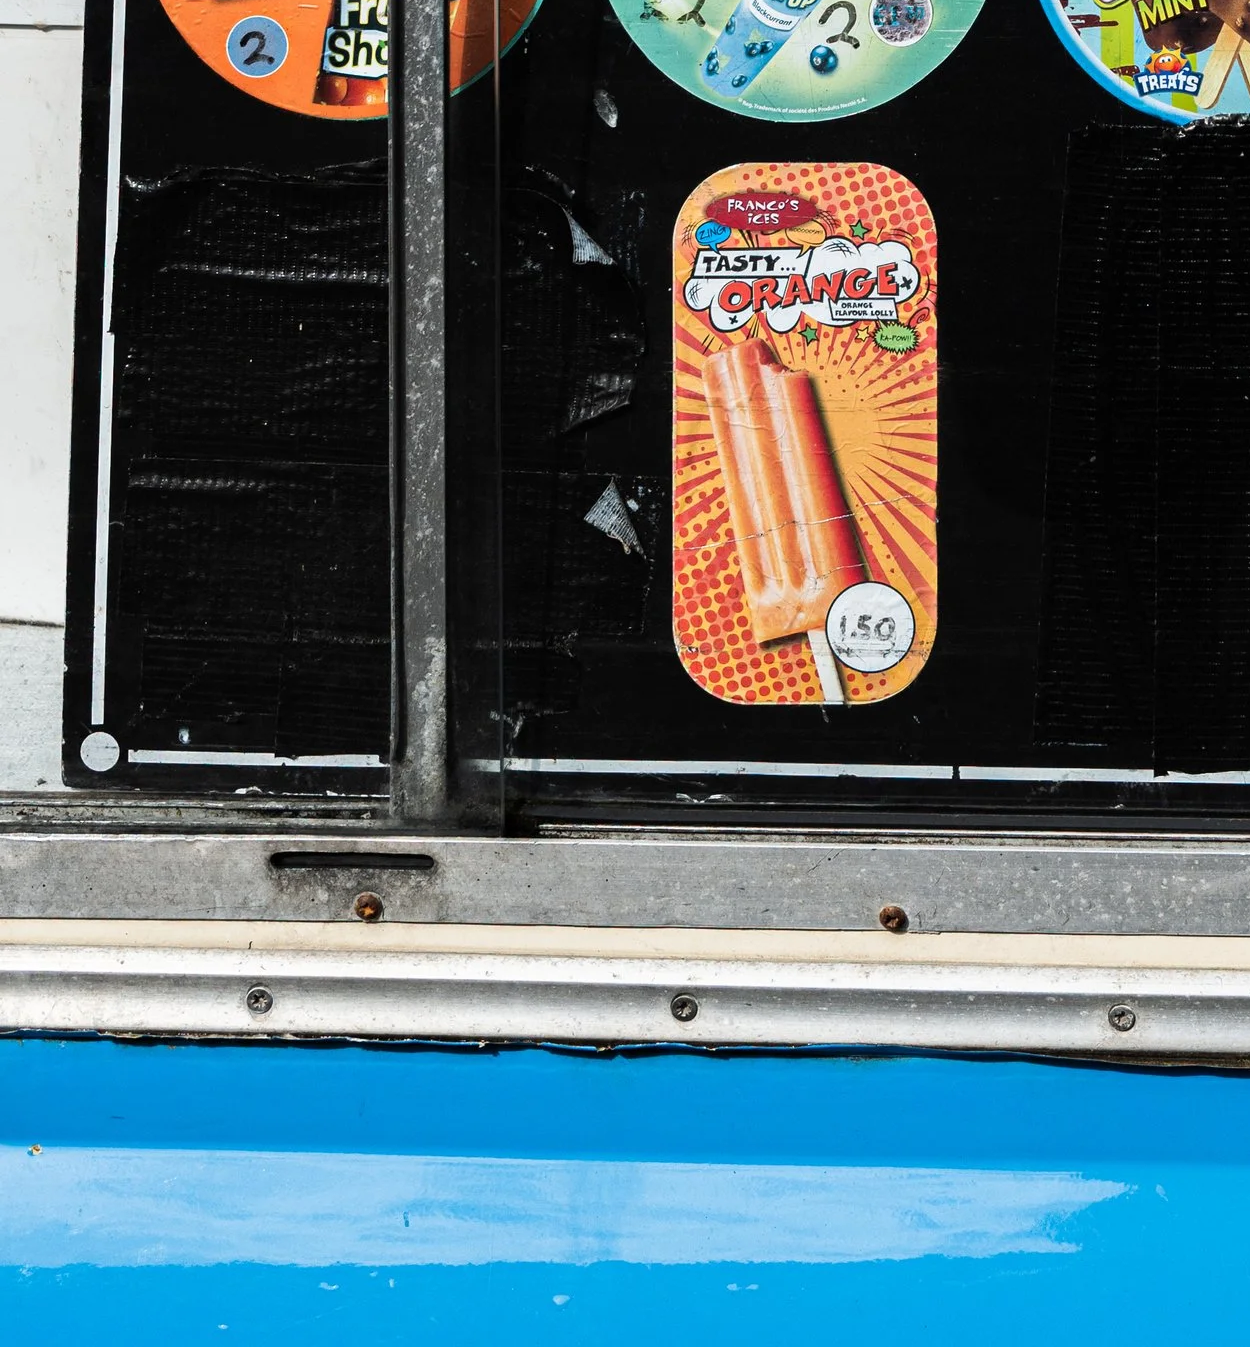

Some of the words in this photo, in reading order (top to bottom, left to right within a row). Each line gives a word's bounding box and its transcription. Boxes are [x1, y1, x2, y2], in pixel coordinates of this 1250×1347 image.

[818, 0, 861, 50] 2
[239, 30, 277, 67] 2
[1137, 68, 1200, 93] TREATS
[717, 262, 900, 314] ORANGE
[870, 309, 895, 317] LOLLY
